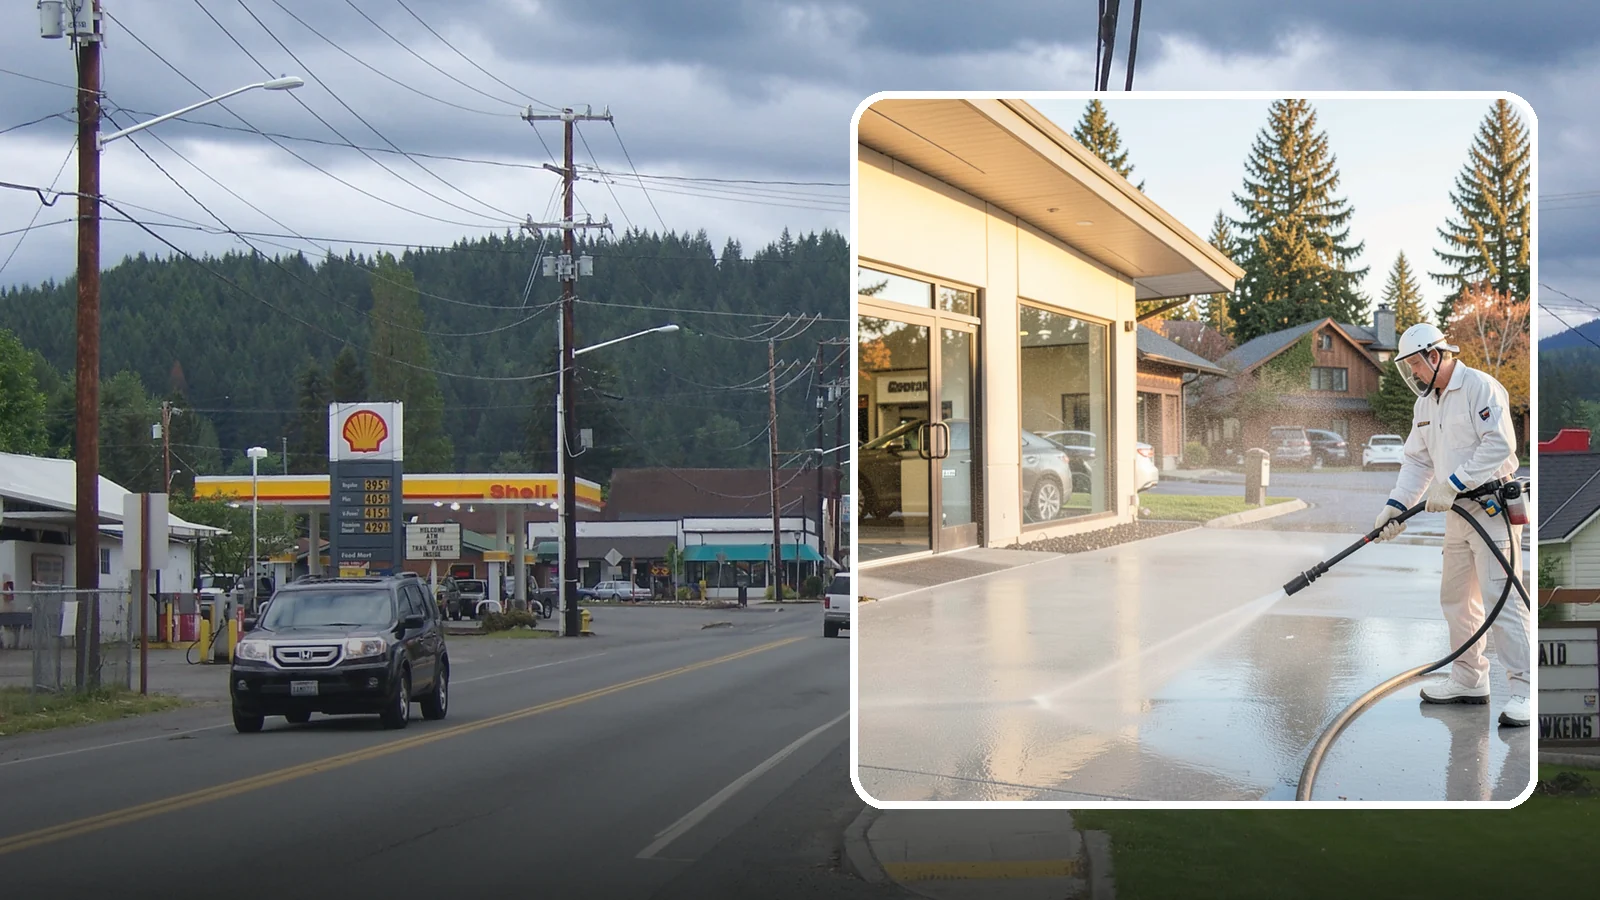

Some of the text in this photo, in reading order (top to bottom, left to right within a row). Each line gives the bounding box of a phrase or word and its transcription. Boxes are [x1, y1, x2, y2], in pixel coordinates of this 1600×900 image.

[490, 484, 547, 499] Shell
[1539, 643, 1567, 666] AID
[1539, 716, 1592, 739] WKENS
